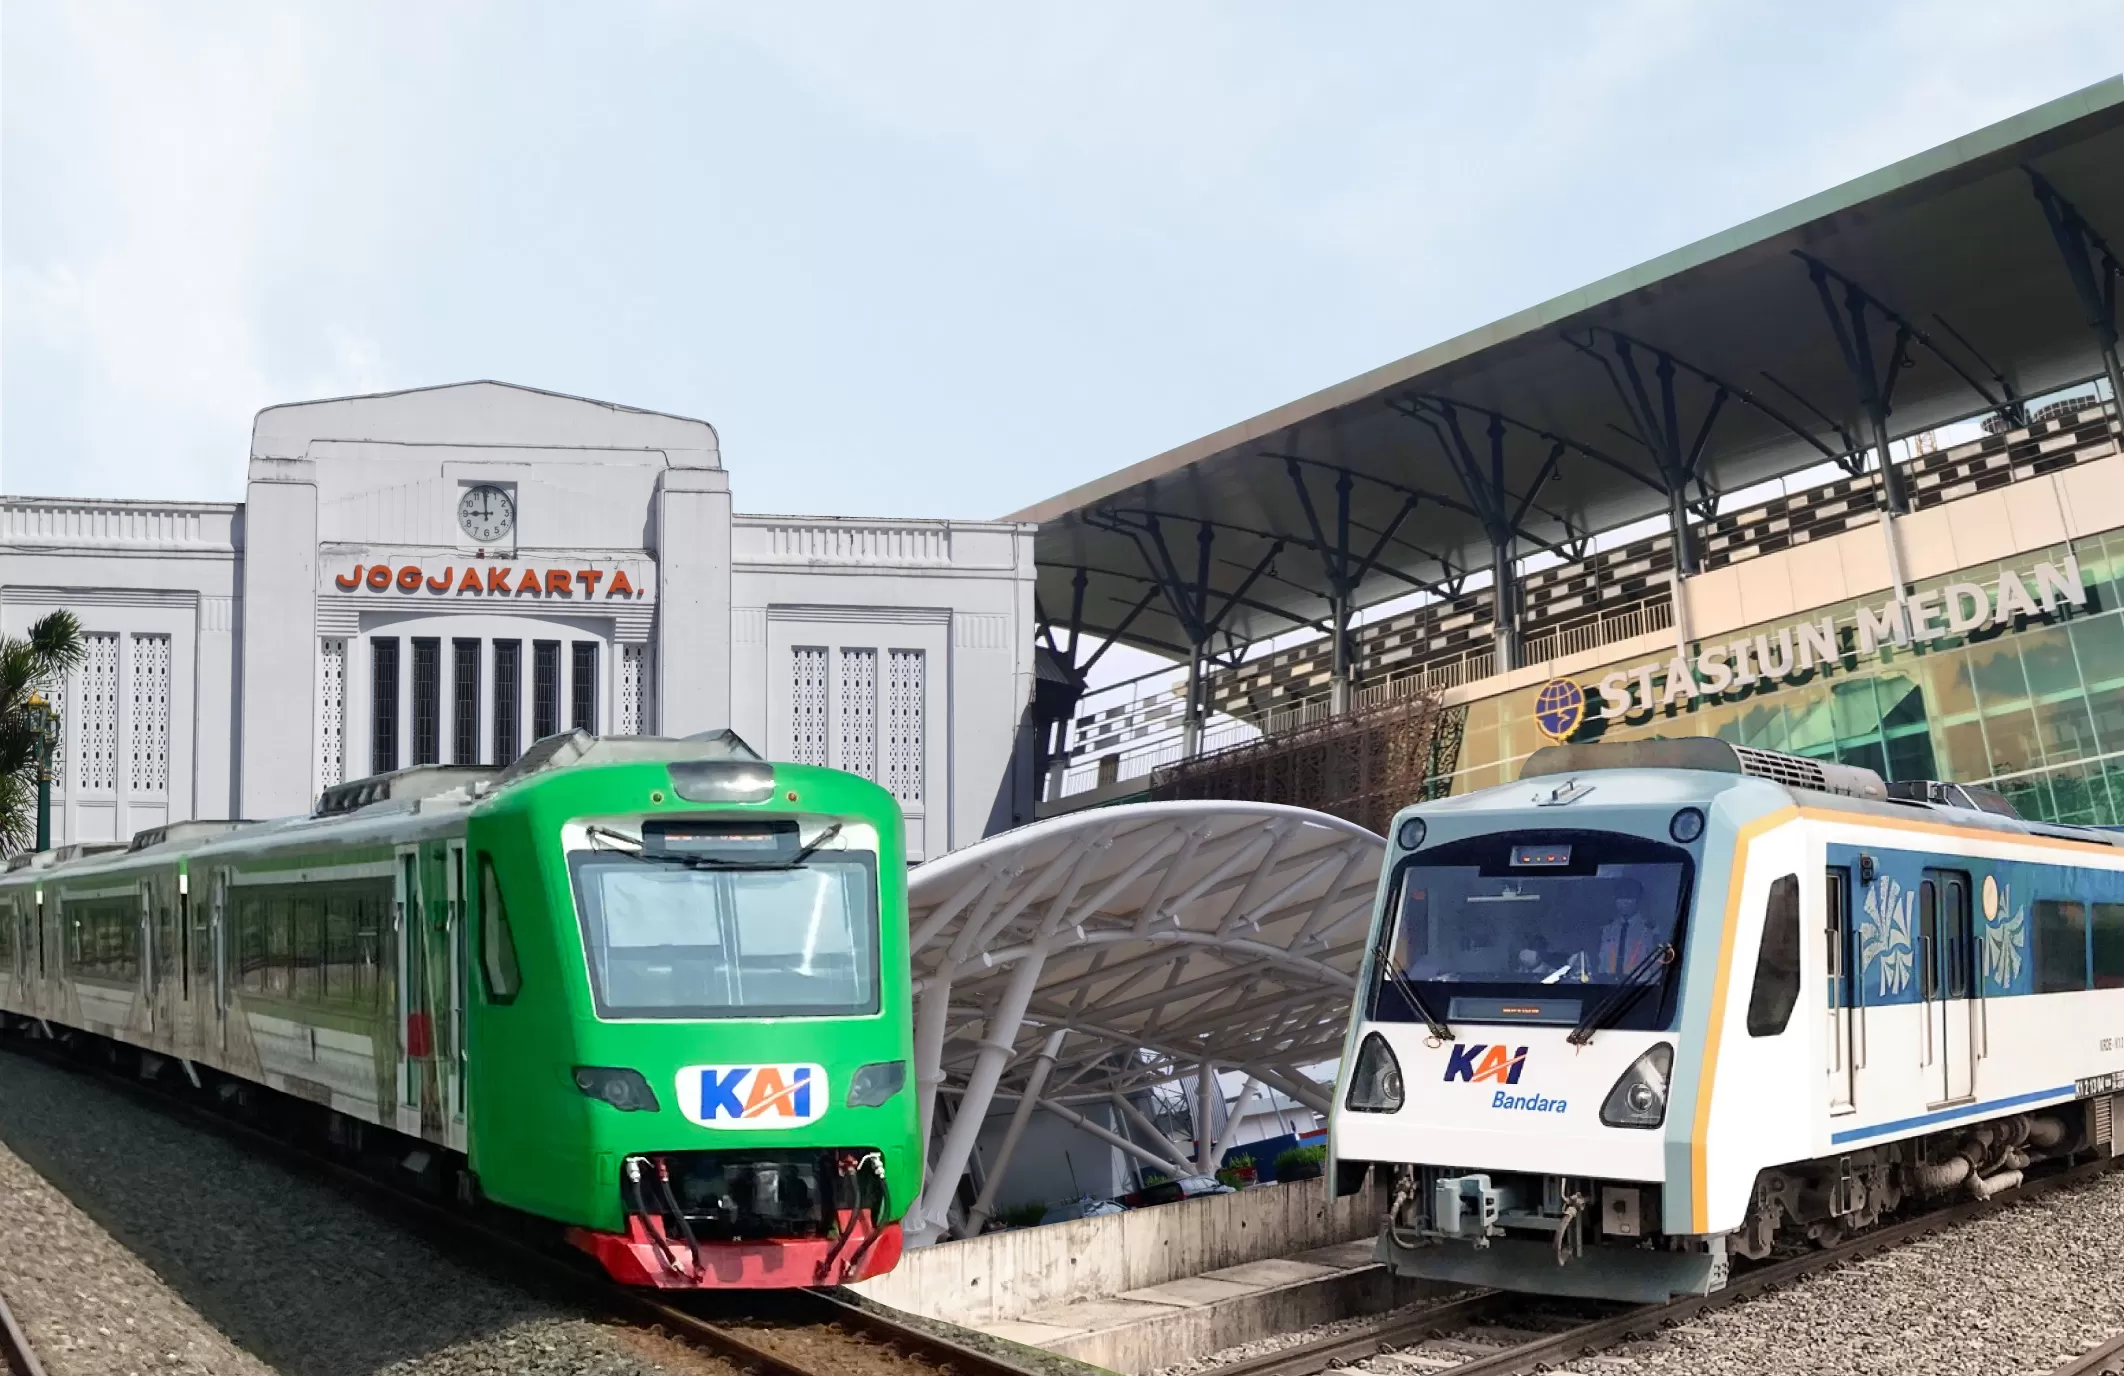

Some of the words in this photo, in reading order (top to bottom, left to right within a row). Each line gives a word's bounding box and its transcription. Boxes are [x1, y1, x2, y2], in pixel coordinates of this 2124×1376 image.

[474, 492, 480, 500] 11
[465, 500, 474, 508] 10
[500, 499, 507, 507] 2
[462, 510, 469, 518] 9
[504, 509, 509, 517] 3
[466, 519, 472, 528] 8
[500, 519, 506, 527] 4
[473, 527, 479, 537] 7
[483, 529, 490, 537] 6
[494, 526, 500, 534] 5
[1600, 616, 1840, 719] STASIUN
[1856, 555, 2087, 655] MEDAN
[1443, 1044, 1529, 1085] KAI
[700, 1067, 811, 1121] KAI
[1492, 1091, 1567, 1113] Bandara
